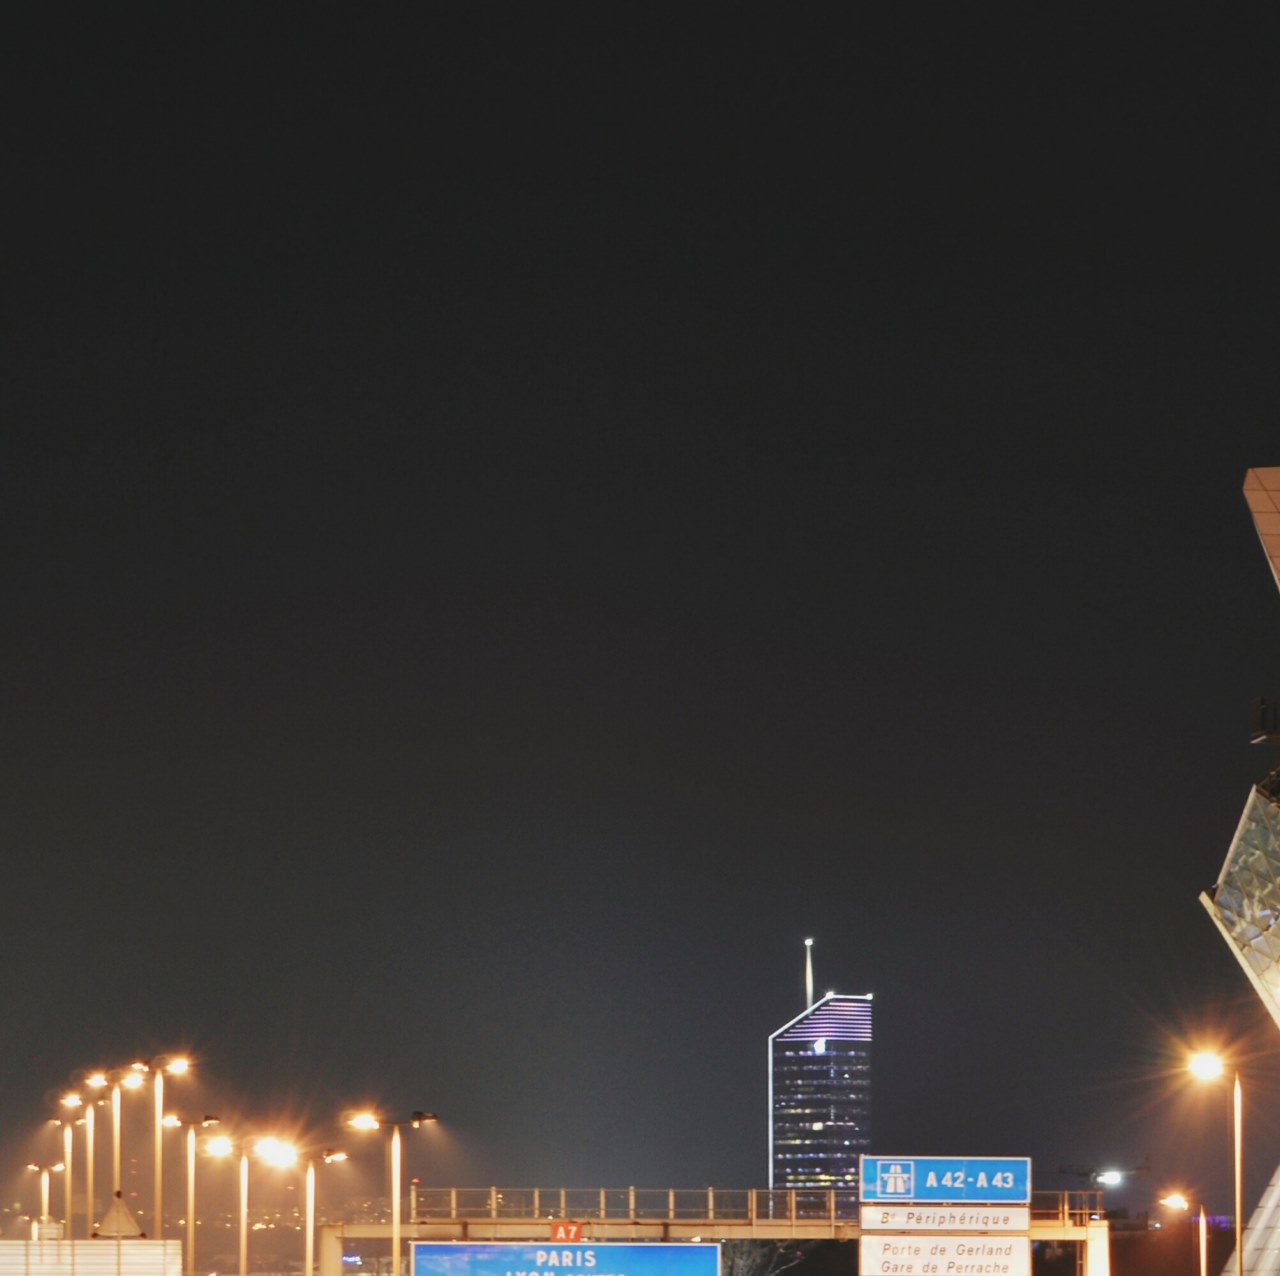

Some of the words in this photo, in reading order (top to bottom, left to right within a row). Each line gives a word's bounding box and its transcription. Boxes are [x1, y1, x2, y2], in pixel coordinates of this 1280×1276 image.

[906, 1212, 1010, 1227] Périphérique
[882, 1243, 921, 1256] Porte
[930, 1244, 946, 1256] de
[956, 1243, 1013, 1256] Gerland
[536, 1250, 596, 1266] PARIS
[881, 1260, 913, 1274] Gare
[922, 1261, 938, 1274] de
[946, 1261, 1009, 1274] Perrache
